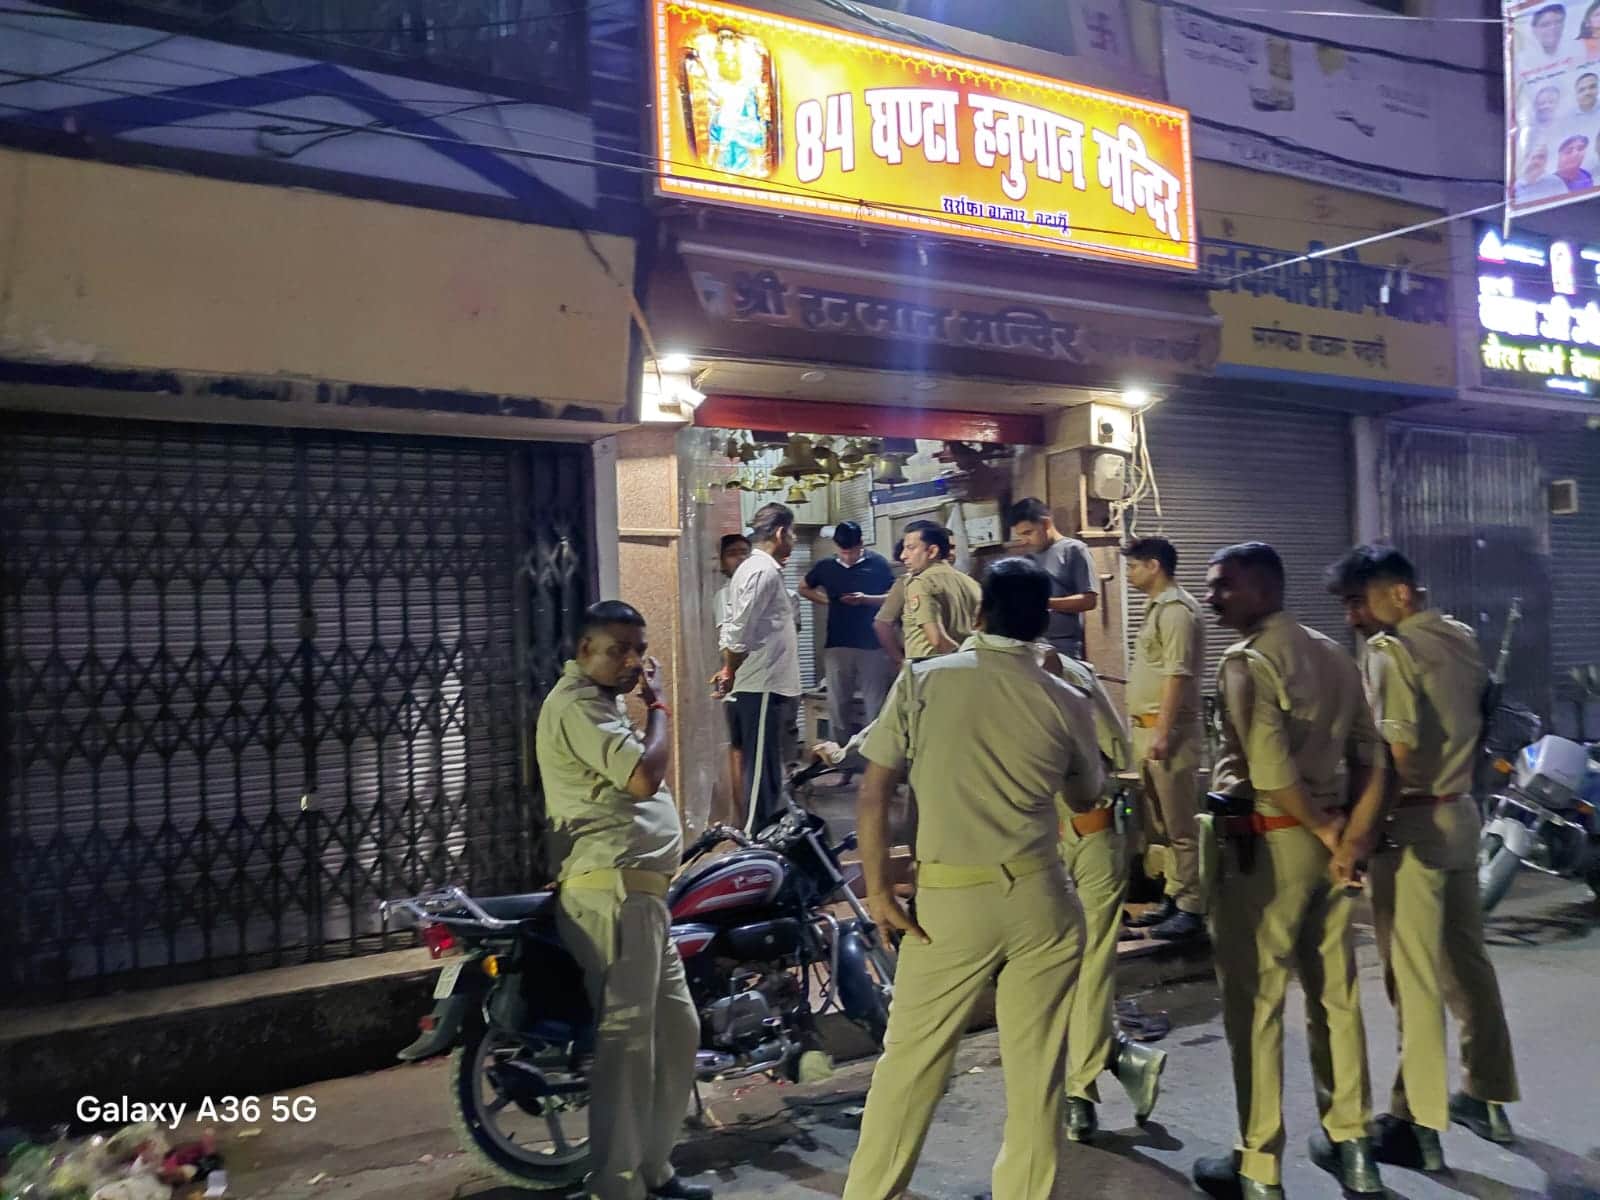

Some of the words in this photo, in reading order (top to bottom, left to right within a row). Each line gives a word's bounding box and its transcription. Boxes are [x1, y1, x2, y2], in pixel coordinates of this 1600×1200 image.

[796, 93, 855, 183] 84
[864, 87, 960, 165] घण्टा
[967, 93, 1086, 200] हनुमान
[1092, 123, 1181, 241] मन्दिर
